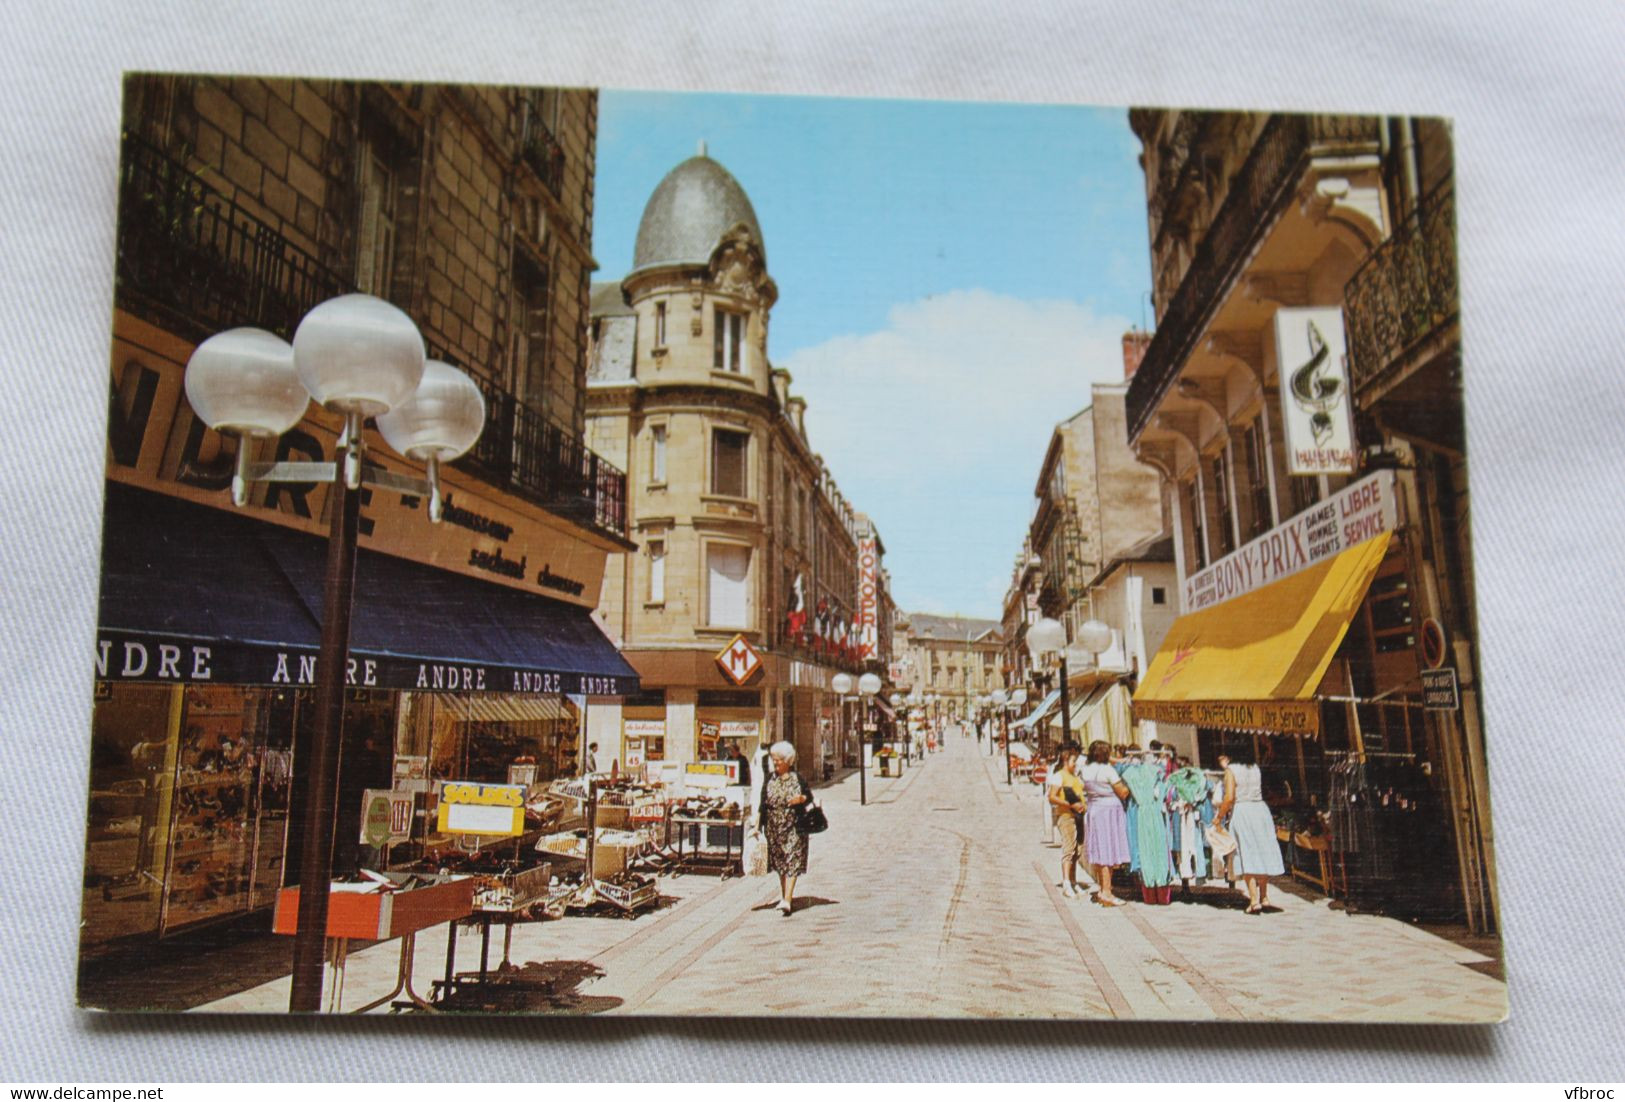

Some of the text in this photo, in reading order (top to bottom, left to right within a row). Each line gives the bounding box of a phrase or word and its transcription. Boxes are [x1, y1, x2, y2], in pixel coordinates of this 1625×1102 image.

[1340, 480, 1381, 519] LIBRE
[1305, 502, 1336, 530] DAMES
[1344, 509, 1385, 547] SERVICE
[1307, 520, 1338, 546] HOMMES
[1215, 519, 1307, 599] BONY-PRIX
[1309, 536, 1340, 561] ENFANTS
[860, 539, 876, 658] MONOPRIX
[272, 652, 377, 687] ANRE
[730, 648, 748, 671] M
[416, 664, 486, 691] ANDRE
[513, 671, 561, 693] ANDRE
[580, 676, 617, 695] ANDRE
[1196, 702, 1254, 725] CONFECTION
[1280, 706, 1306, 728] Service
[443, 784, 524, 808] SOLDES
